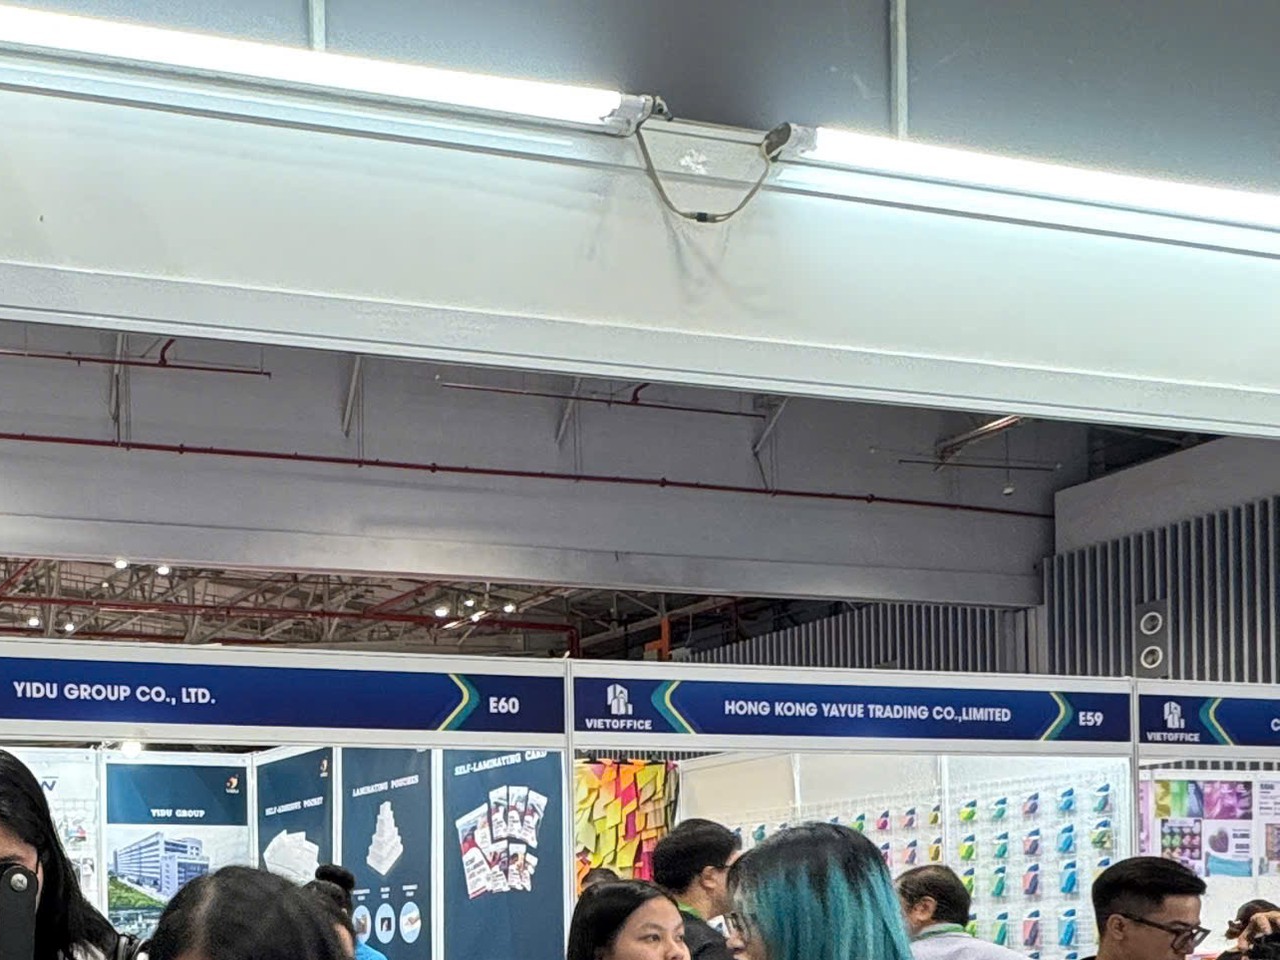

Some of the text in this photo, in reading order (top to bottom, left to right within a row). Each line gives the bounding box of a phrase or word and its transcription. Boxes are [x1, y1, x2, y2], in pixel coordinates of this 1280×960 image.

[13, 681, 216, 705] YIDU GROUP CO., LTD.
[489, 697, 519, 714] E60
[724, 700, 770, 715] HONG
[774, 702, 817, 717] KONG
[821, 703, 864, 718] YAYUE
[868, 704, 929, 720] TRADING
[585, 718, 652, 730] VIETOFFICE
[1079, 711, 1103, 726] E59
[1146, 732, 1200, 742] VIETOFFICE
[150, 809, 205, 817] YIDU GROUP
